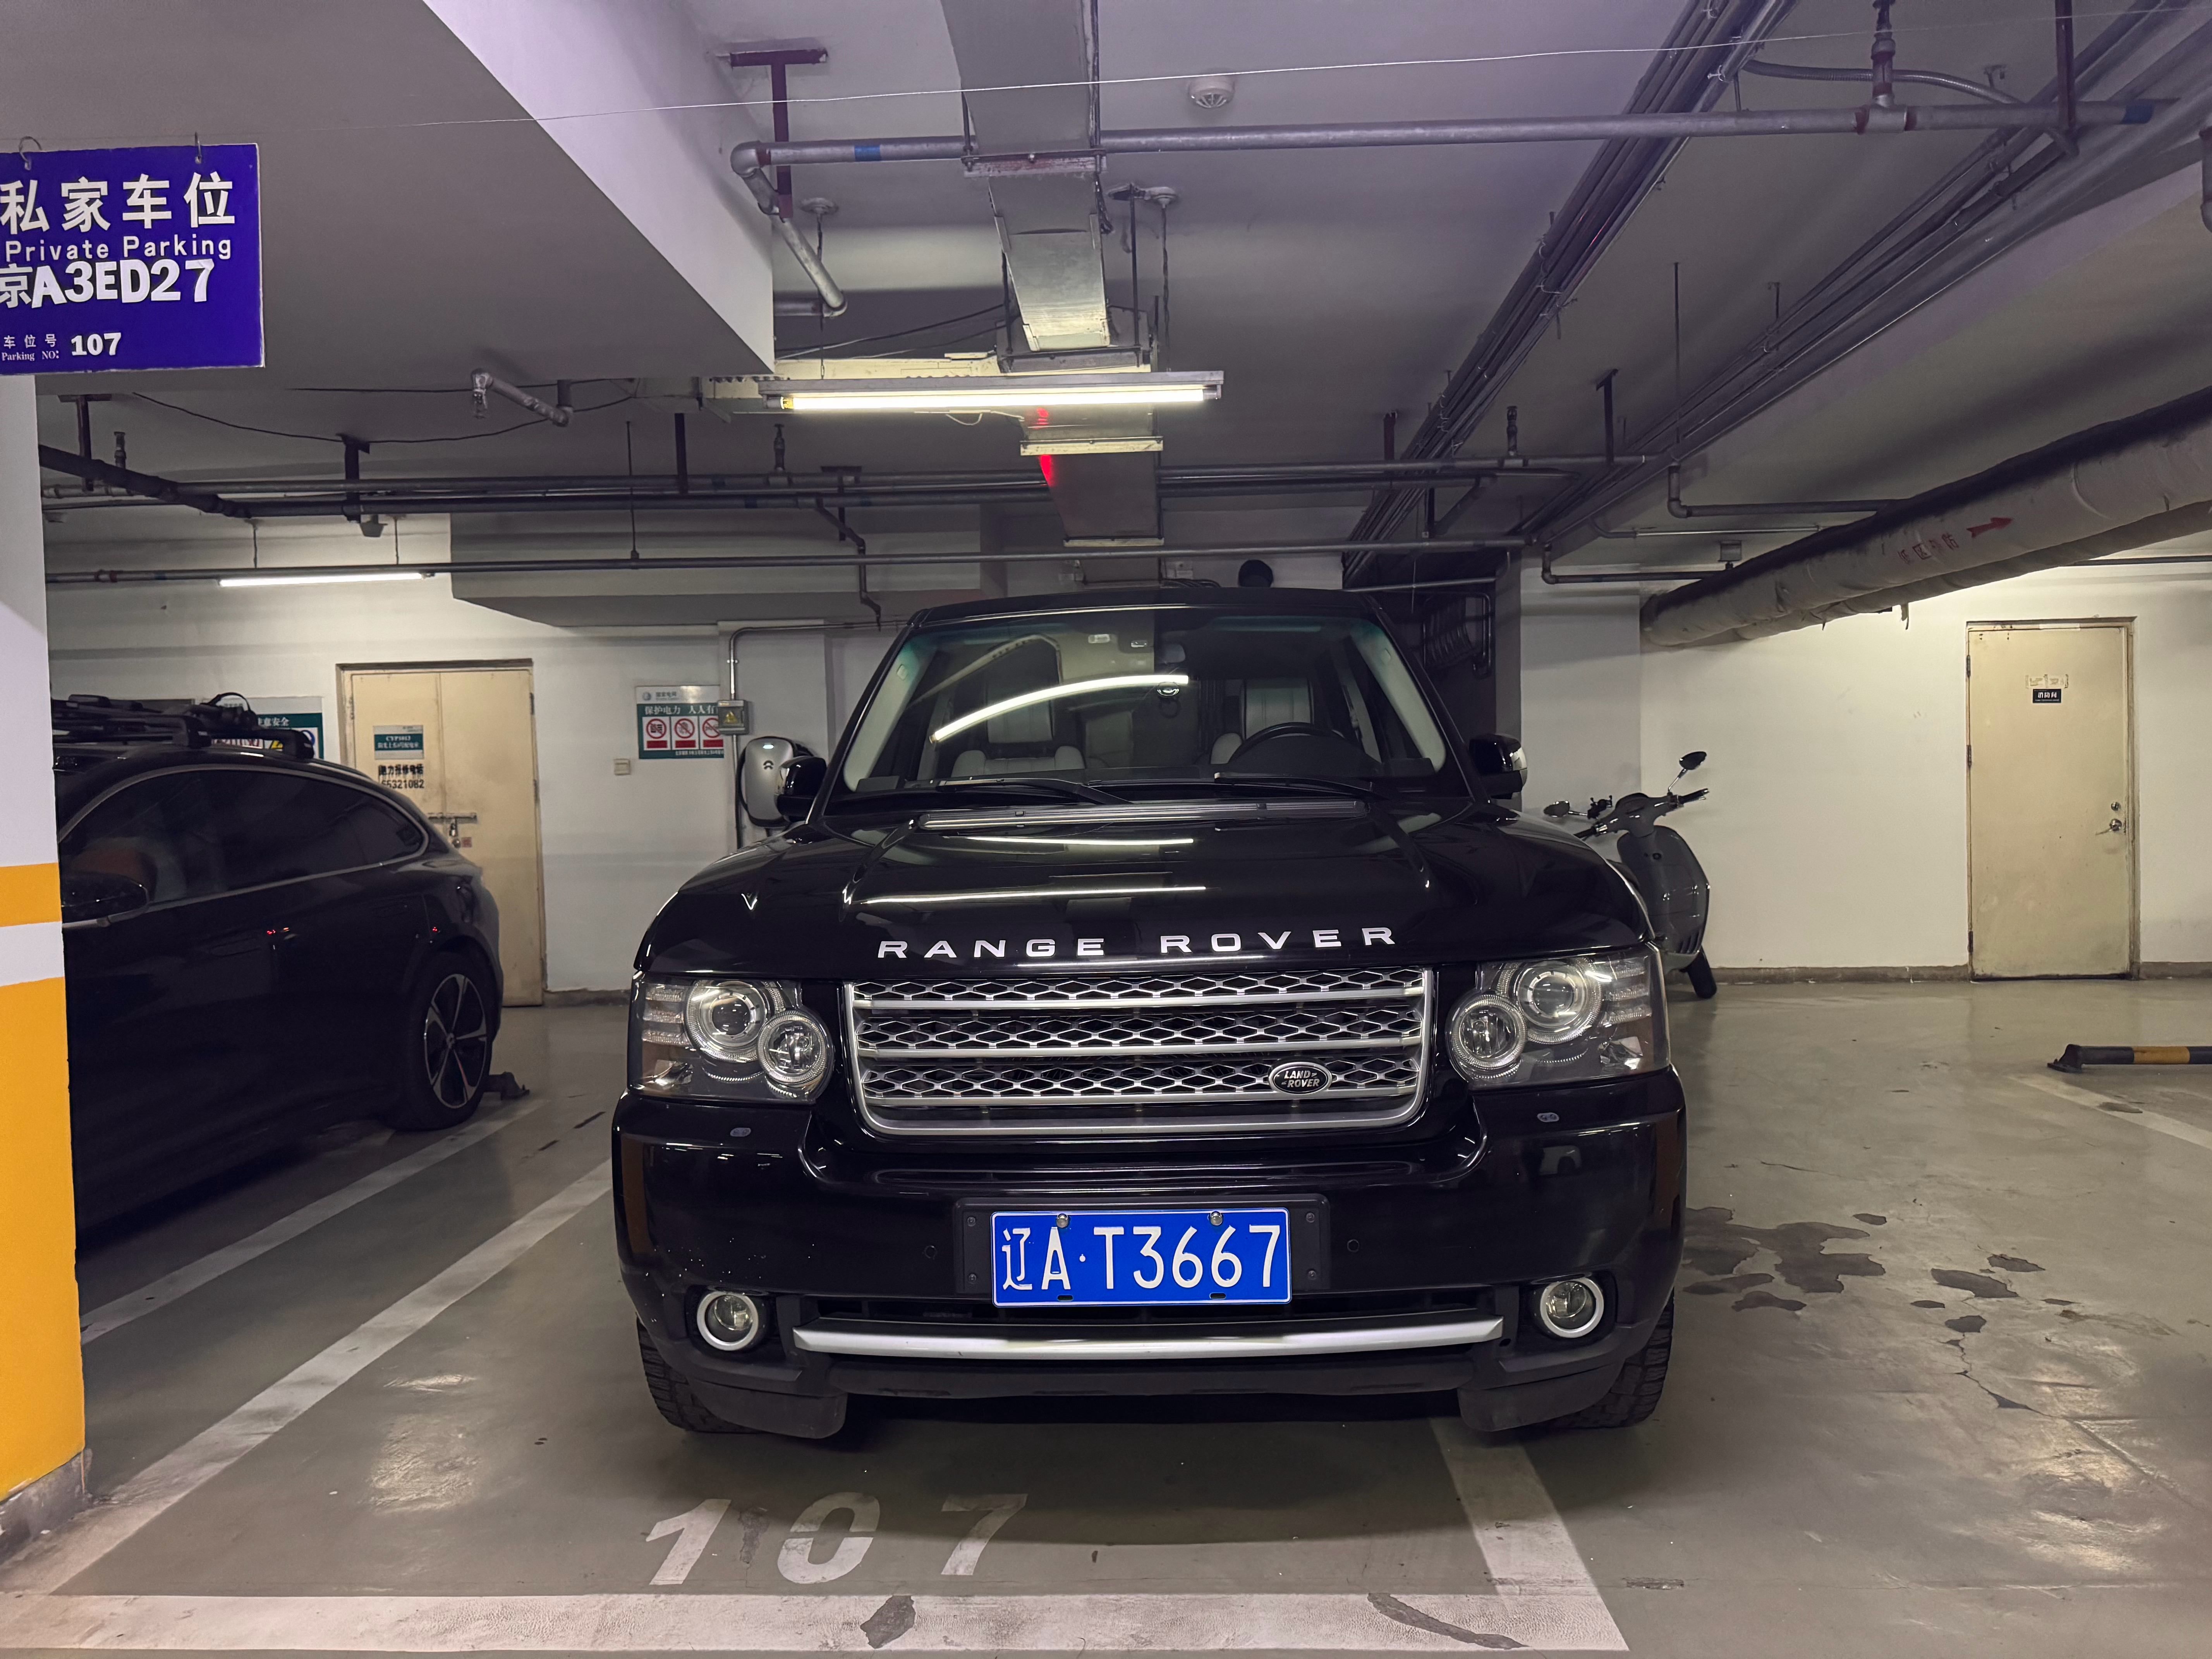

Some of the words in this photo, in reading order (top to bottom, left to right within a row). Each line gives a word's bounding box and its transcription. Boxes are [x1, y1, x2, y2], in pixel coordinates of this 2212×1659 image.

[0, 171, 235, 234] 私家车位
[6, 240, 109, 261] Private
[124, 234, 231, 259] Parking
[0, 259, 214, 308] 京A3ED27
[2, 352, 35, 361] Parking
[3, 334, 57, 349] 车位号
[71, 332, 121, 356] 107
[645, 706, 680, 715] 保护电力
[689, 705, 718, 714] 人人有
[878, 938, 1104, 958] RANGE
[1161, 927, 1395, 954] ROVER
[1284, 1070, 1310, 1079] LAND
[1287, 1079, 1320, 1088] ROVER
[645, 1492, 1028, 1585] 107
